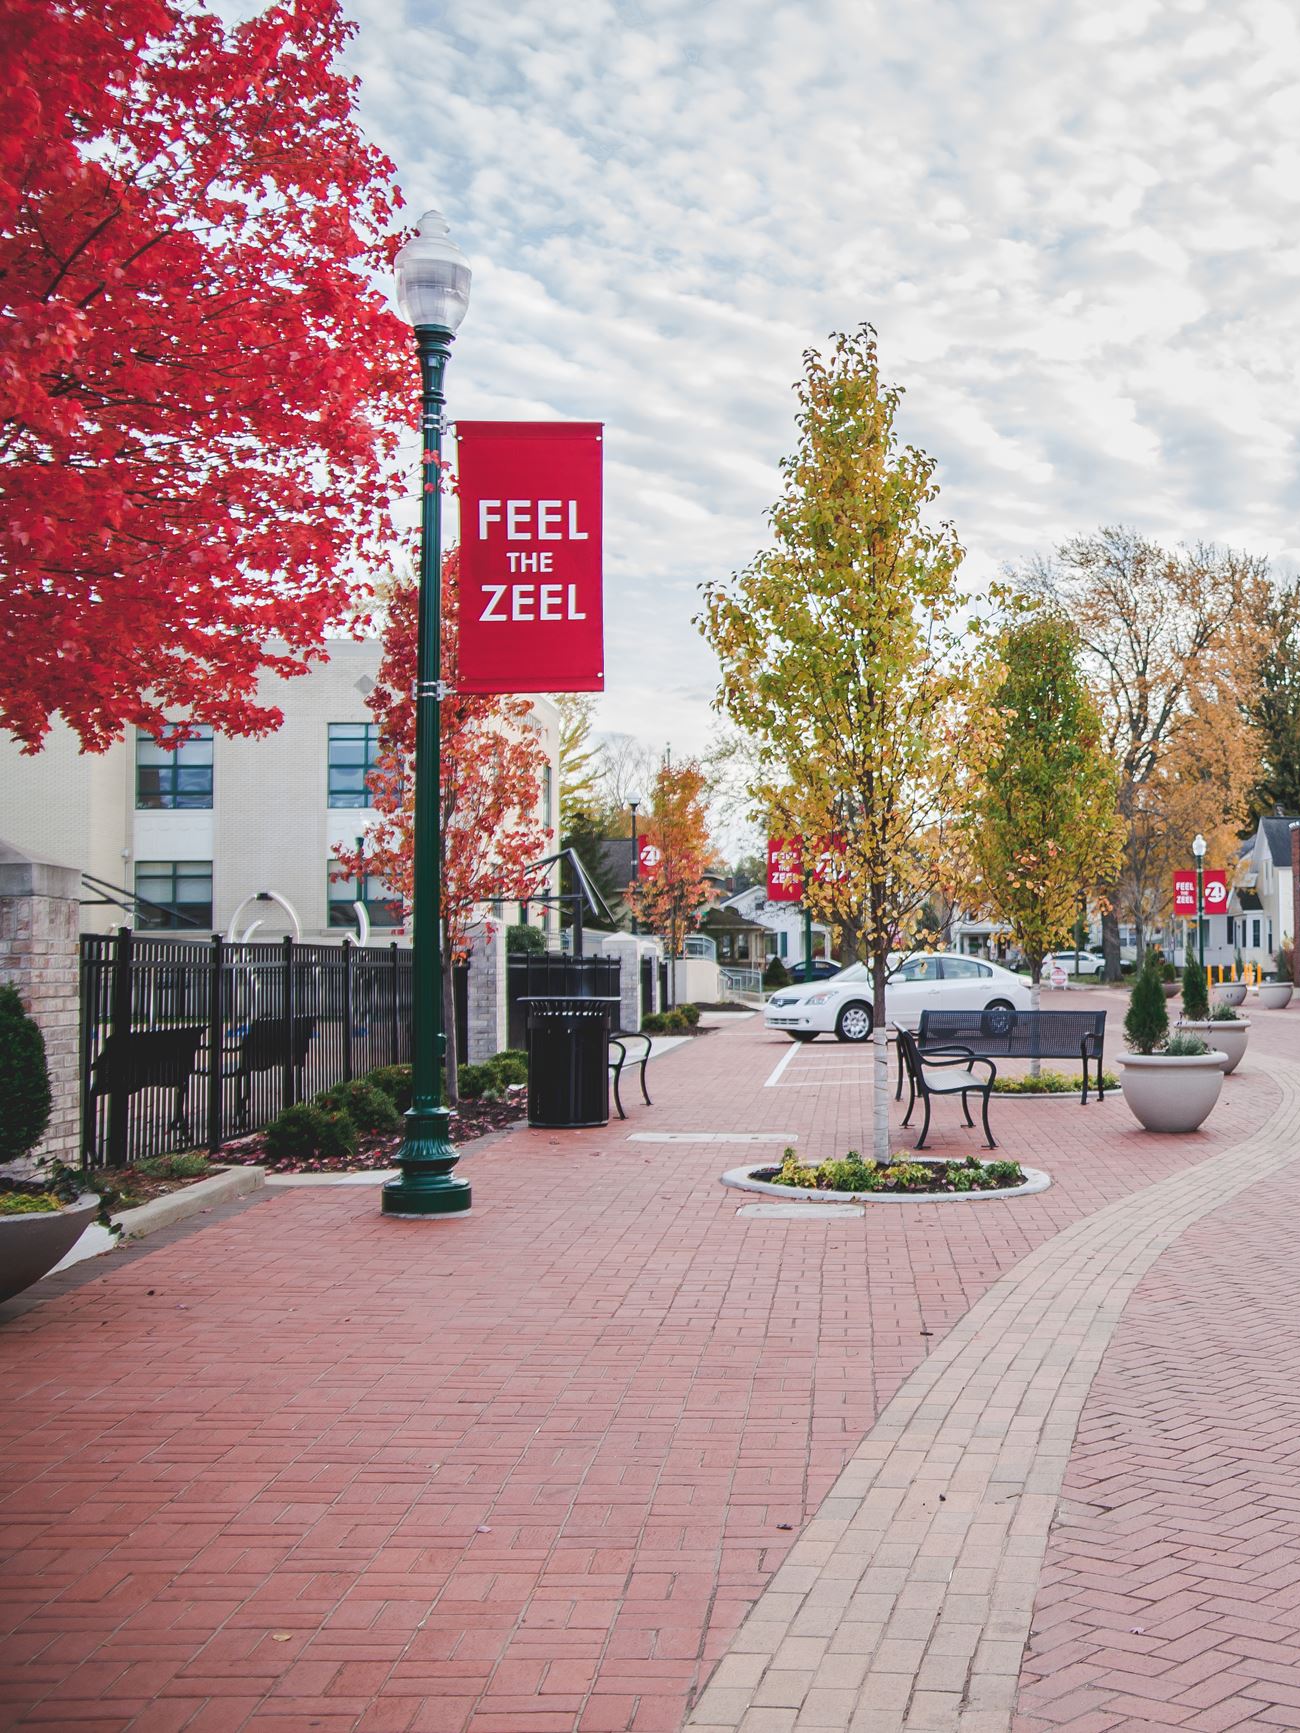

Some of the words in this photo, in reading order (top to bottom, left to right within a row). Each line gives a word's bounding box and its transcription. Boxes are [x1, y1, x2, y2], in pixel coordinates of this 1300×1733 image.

[478, 500, 588, 540] FEEL
[506, 552, 553, 572] THE
[478, 584, 587, 622] ZEEL
[1175, 882, 1194, 891] FEEL
